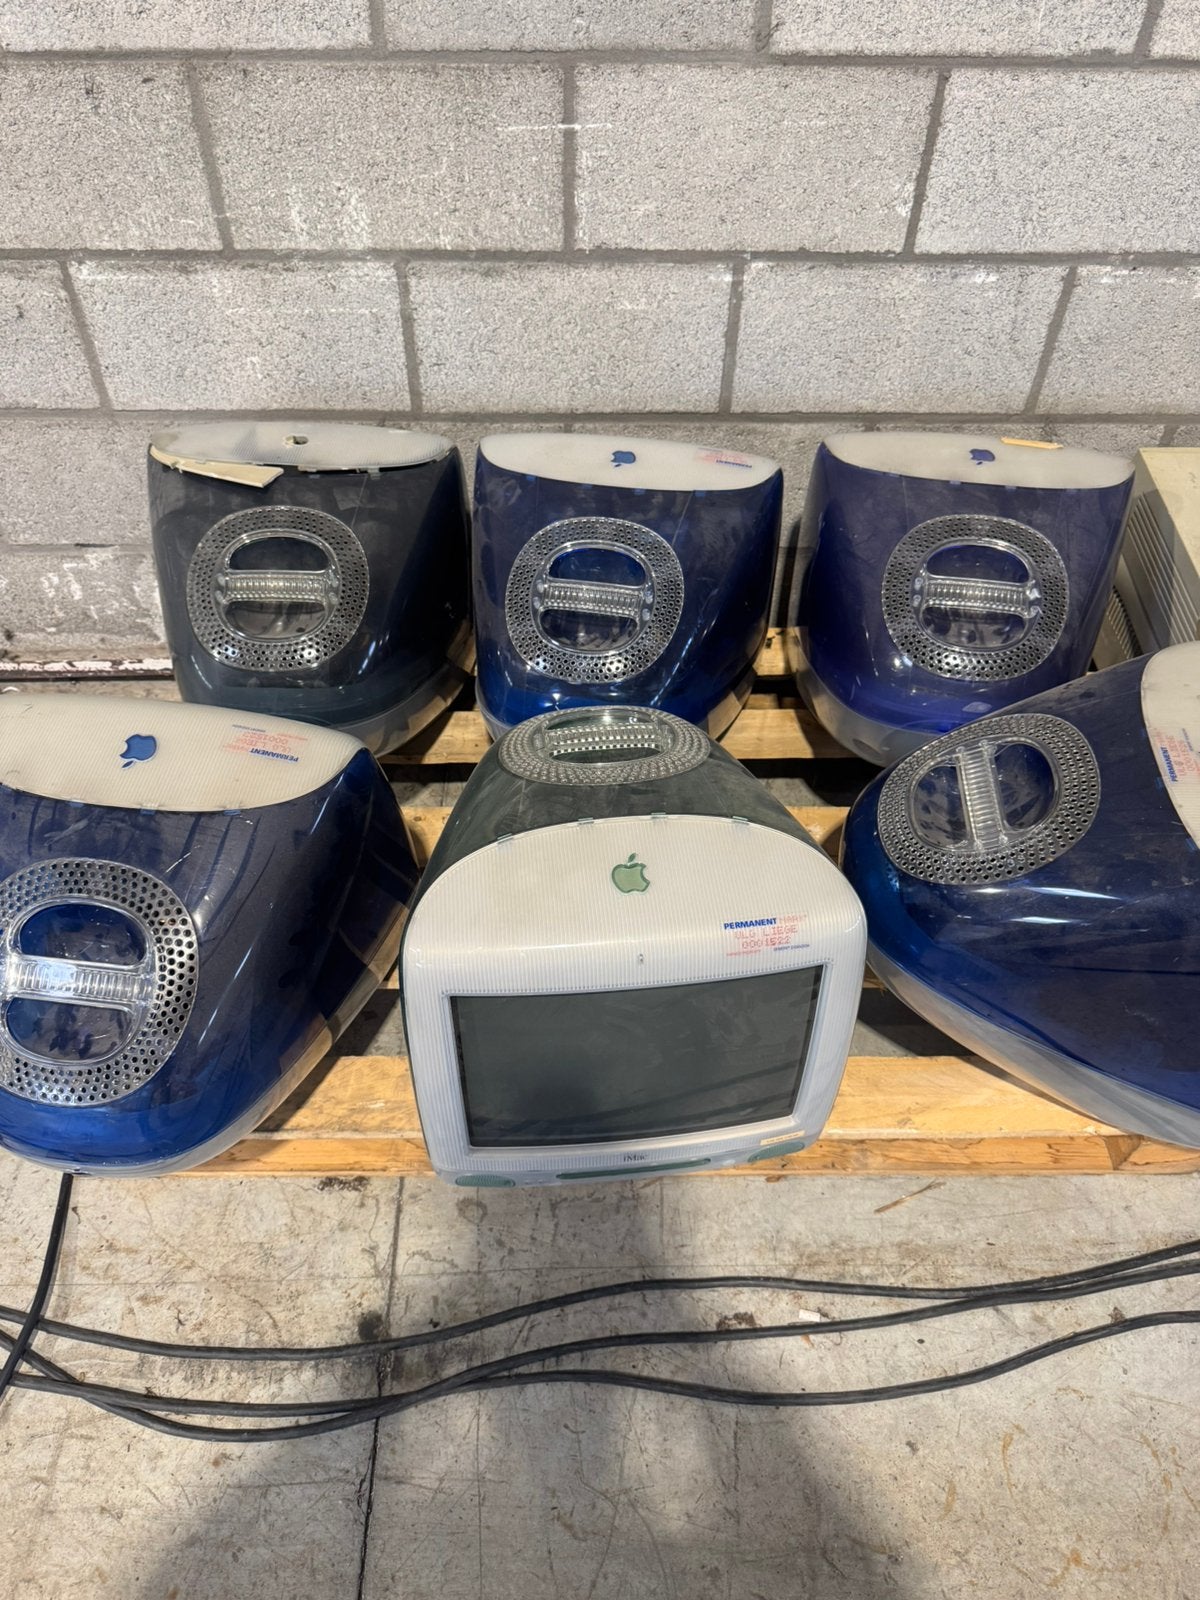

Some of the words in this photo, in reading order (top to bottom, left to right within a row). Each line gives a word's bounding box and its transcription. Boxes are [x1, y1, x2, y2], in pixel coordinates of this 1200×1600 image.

[249, 747, 299, 762] PERMANENT
[723, 917, 777, 930] PERMANENT
[762, 924, 798, 937] LIEGE
[623, 1153, 648, 1162] iMac
